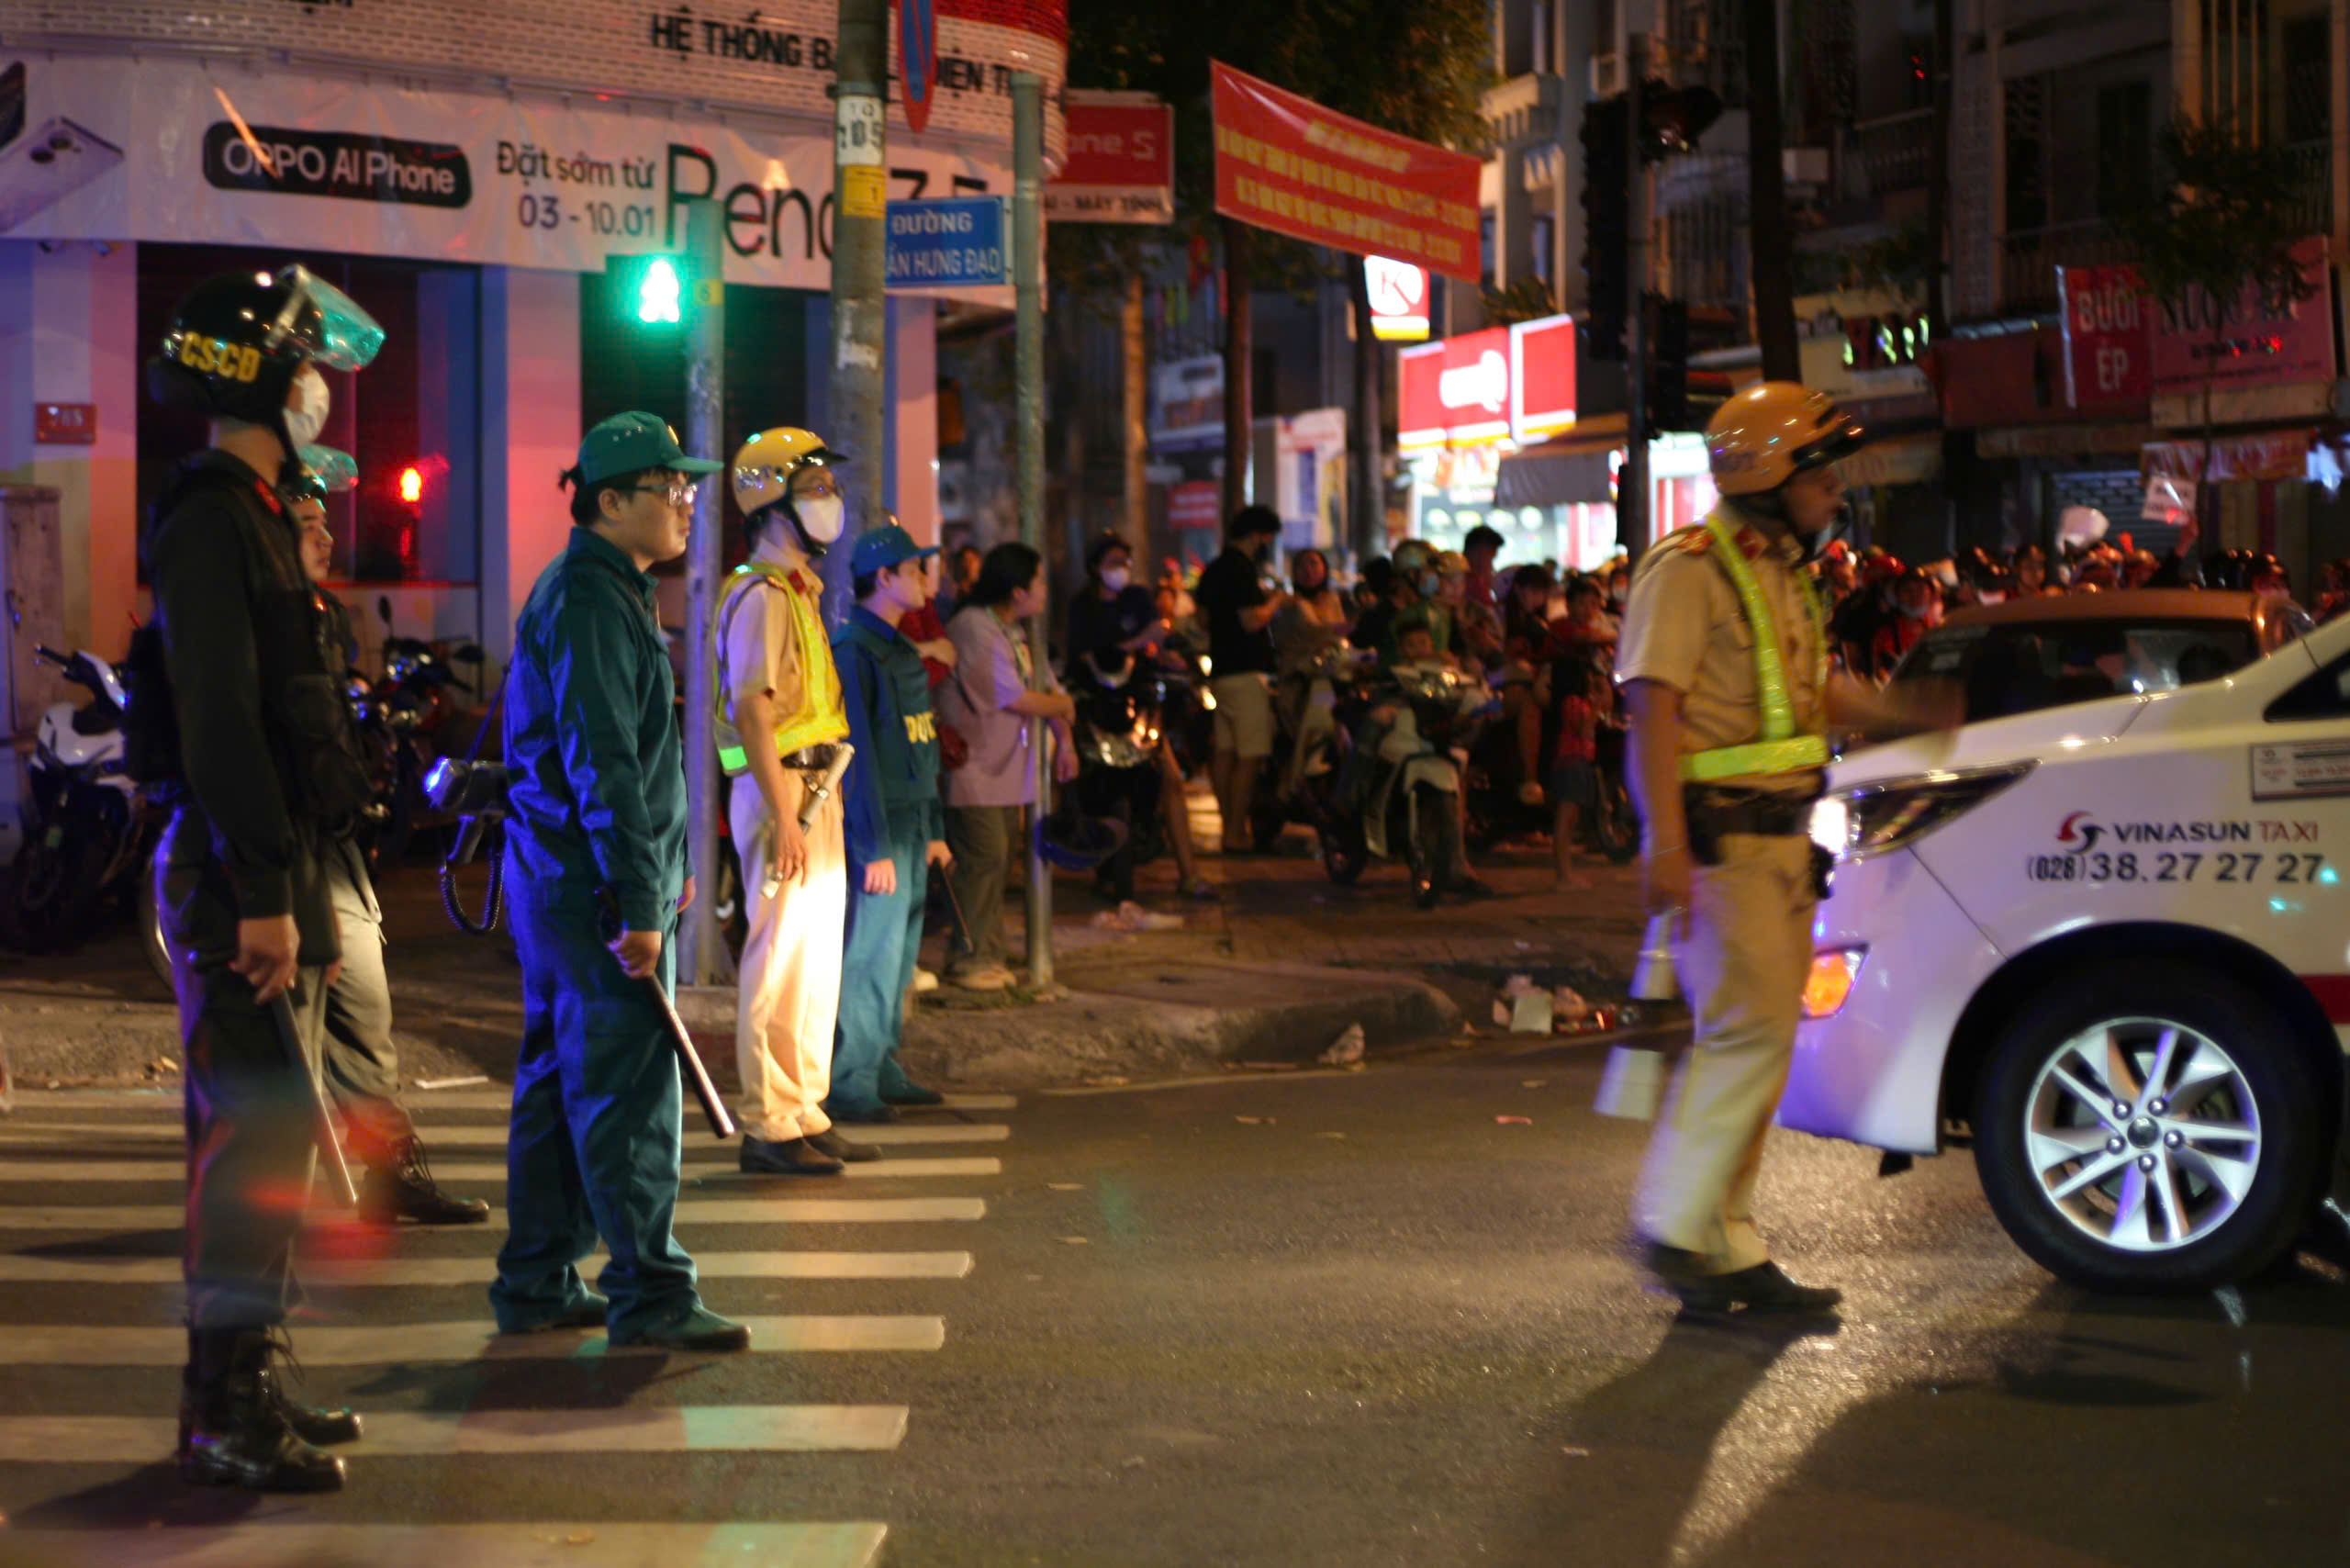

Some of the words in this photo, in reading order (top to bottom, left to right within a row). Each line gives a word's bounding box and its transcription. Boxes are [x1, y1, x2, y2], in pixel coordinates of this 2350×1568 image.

[652, 5, 692, 62] HỆ
[702, 9, 801, 67] THỐNG
[222, 137, 326, 182] OPPO
[331, 146, 360, 184] AI
[364, 149, 456, 196] Phone
[497, 140, 551, 187] Đặt
[554, 150, 615, 187] sớm
[621, 156, 656, 190] từ
[518, 194, 561, 230] 03
[584, 200, 655, 238] 10.01
[891, 207, 974, 235] ĐƯỜNG
[2112, 820, 2250, 844] VINASUN
[2256, 819, 2319, 843] TAXI
[2214, 853, 2263, 883] 27
[2275, 853, 2325, 883] 27
